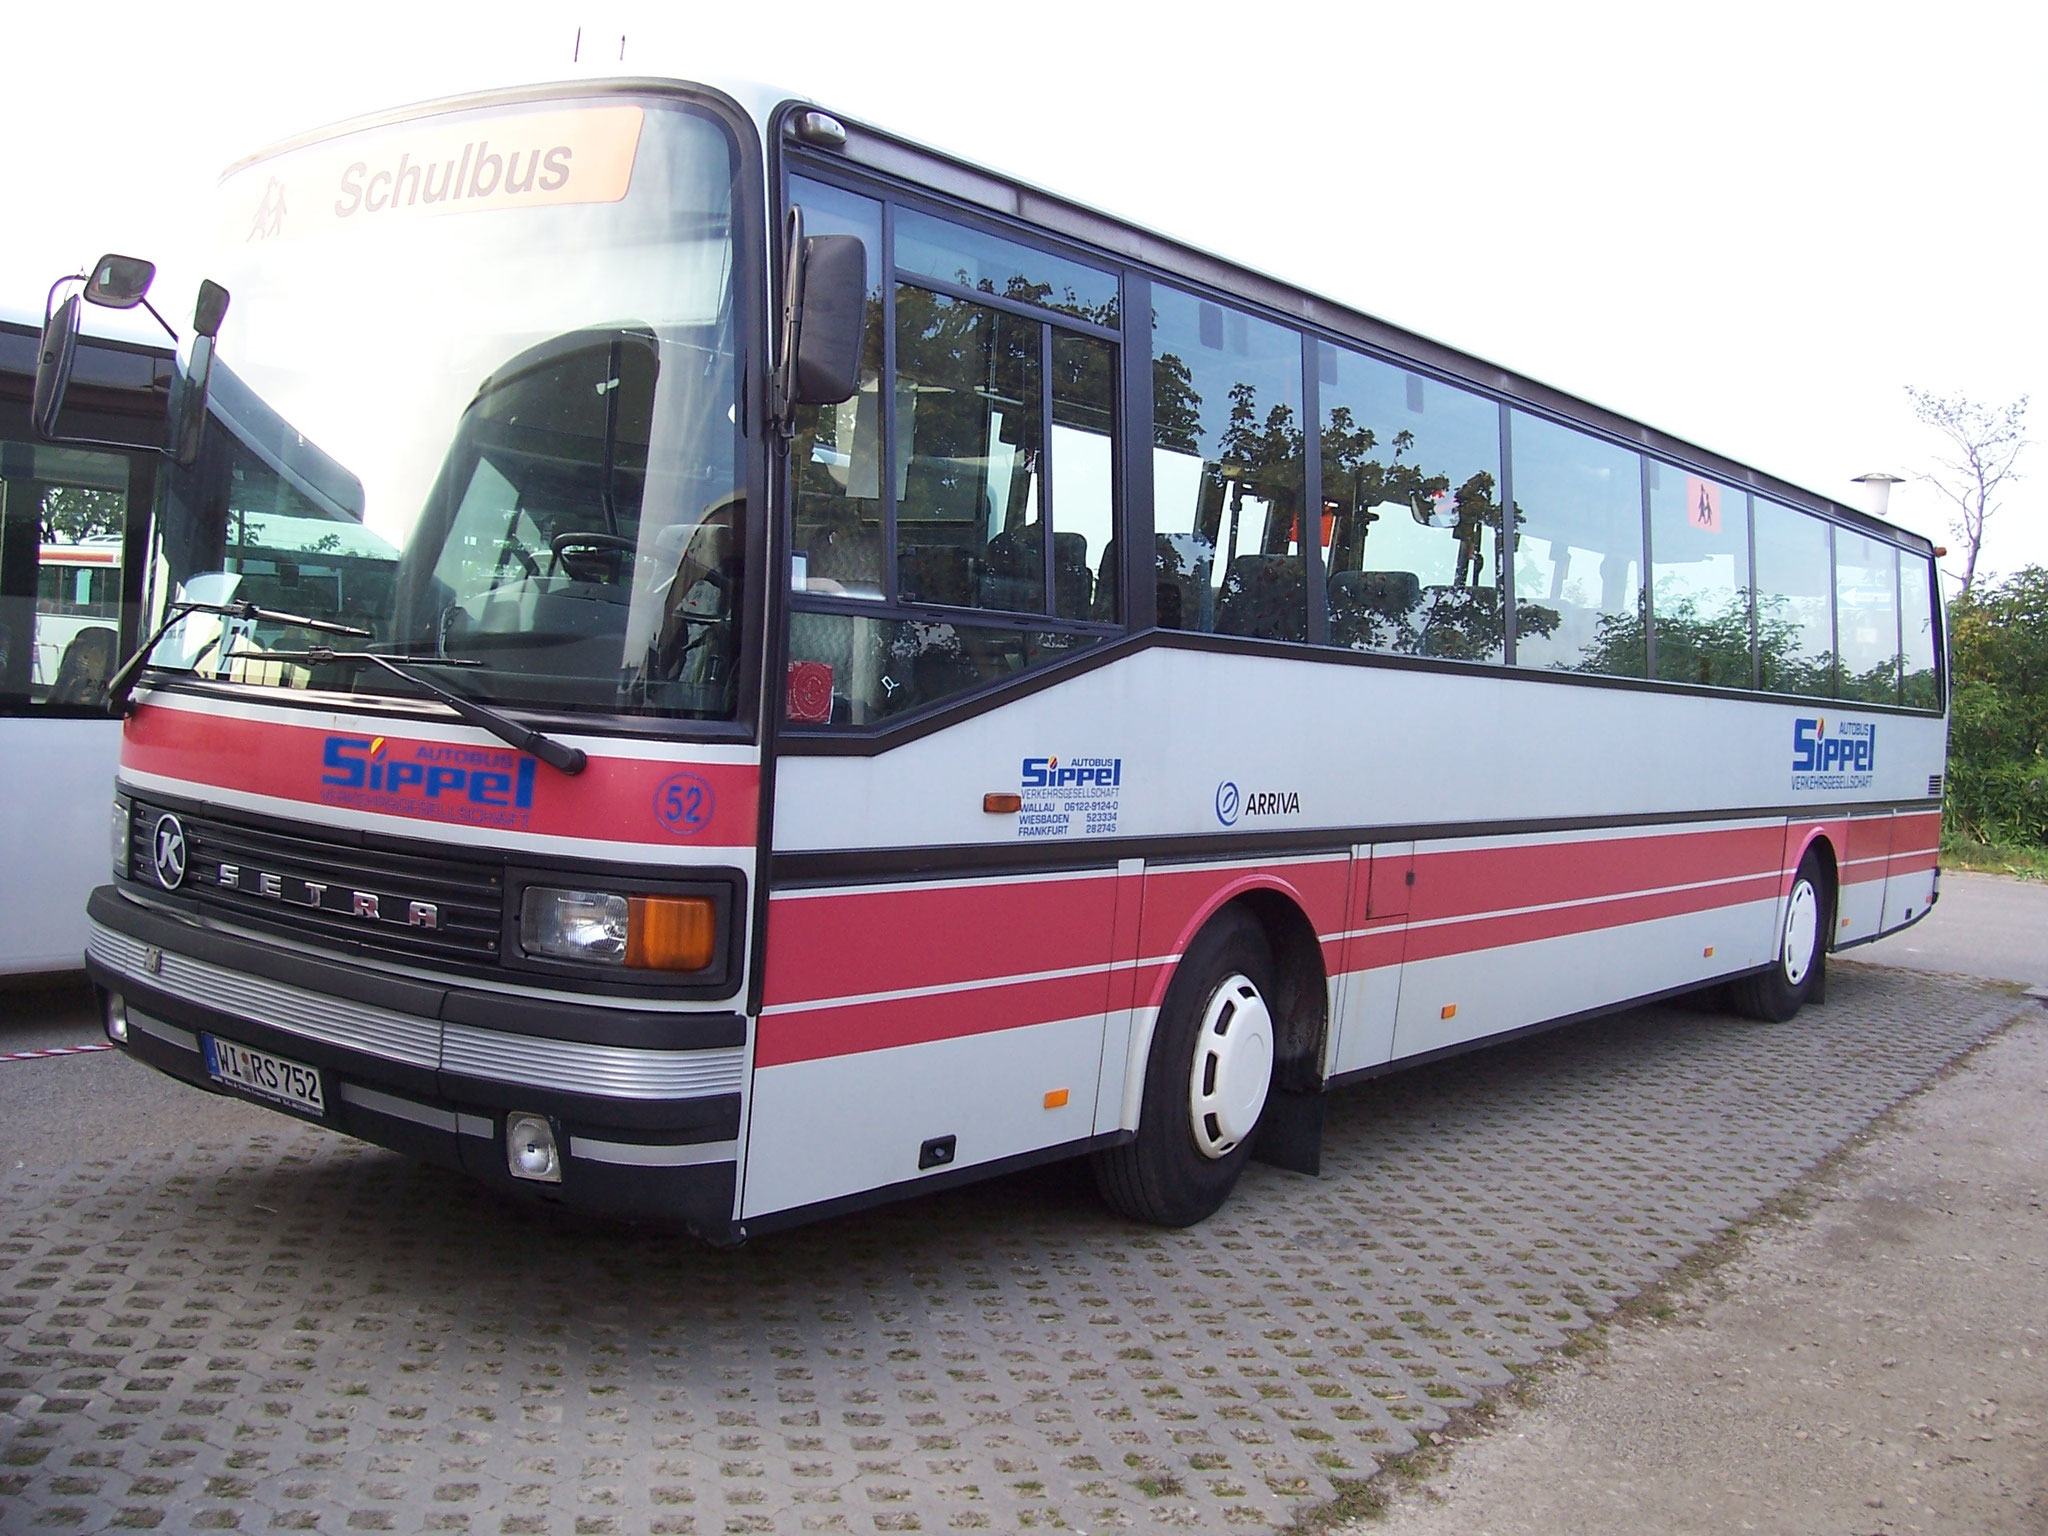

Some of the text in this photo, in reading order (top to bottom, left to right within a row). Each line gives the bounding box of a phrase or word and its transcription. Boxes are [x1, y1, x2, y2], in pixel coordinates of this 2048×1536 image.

[334, 141, 573, 218] Schulbus
[1839, 721, 1869, 736] AUTOBUS
[1792, 718, 1876, 772] Sippel
[415, 746, 514, 769] AUTOBUS
[1071, 758, 1113, 767] AUTOBUS
[322, 736, 538, 810] Sippel
[1021, 757, 1122, 788] Sippel
[1791, 775, 1873, 791] VERKEHRSGESELLSCHAFT
[1020, 787, 1120, 799] VERKEHRSGESELLSCHAFT
[1245, 792, 1300, 816] ARRIVA
[320, 788, 533, 829] VERKEHRSGESELLSCHAFT
[664, 785, 704, 825] 52
[1020, 801, 1119, 813] WALLAU 06122-9124-0
[1018, 823, 1117, 836] FRANKFURT 282745
[1019, 812, 1118, 825] WIESBADEN 523334
[218, 863, 439, 930] SETRA
